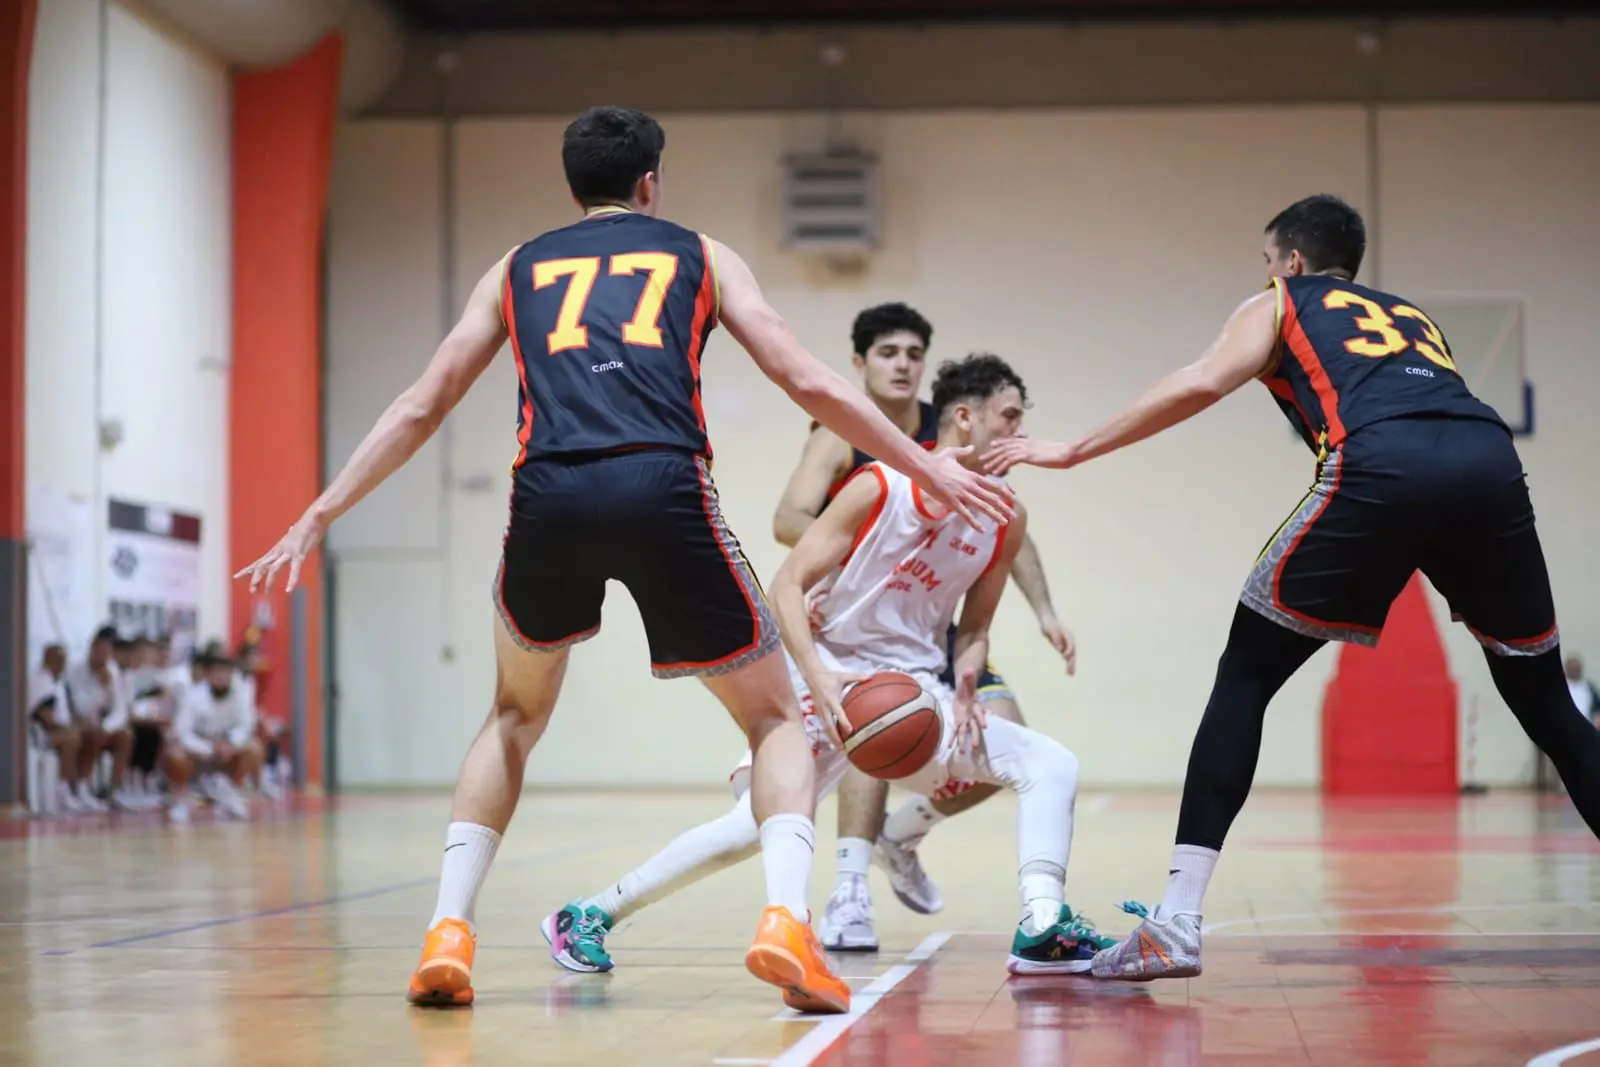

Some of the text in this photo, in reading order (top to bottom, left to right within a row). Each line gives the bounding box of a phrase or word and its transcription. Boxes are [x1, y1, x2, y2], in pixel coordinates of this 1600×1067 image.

[532, 251, 679, 356] 77
[1322, 288, 1457, 372] 33
[591, 360, 624, 373] cmax
[1405, 367, 1436, 378] cmax
